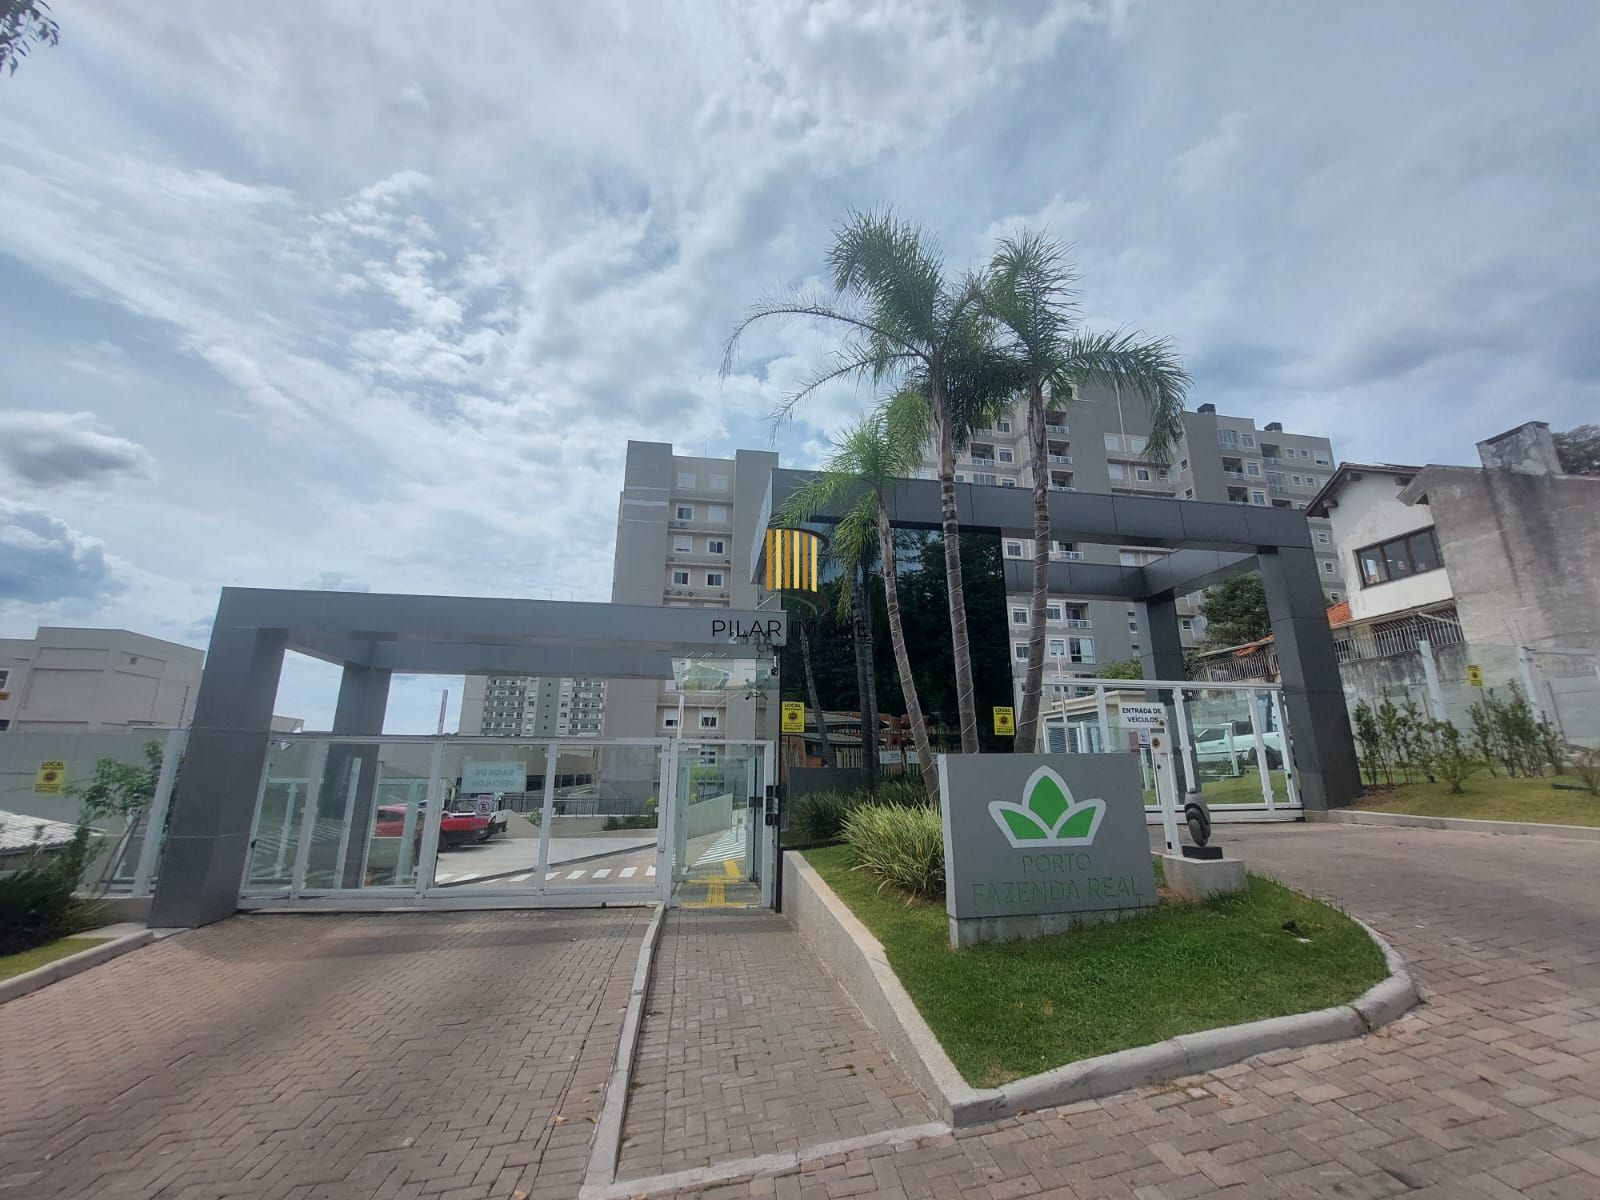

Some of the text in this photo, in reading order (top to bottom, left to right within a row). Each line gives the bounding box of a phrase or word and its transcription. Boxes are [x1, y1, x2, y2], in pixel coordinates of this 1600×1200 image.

[1127, 715, 1159, 723] VEÍCULOS
[1022, 853, 1092, 874] PORTO
[971, 875, 1144, 906] FAZENDA REAL
